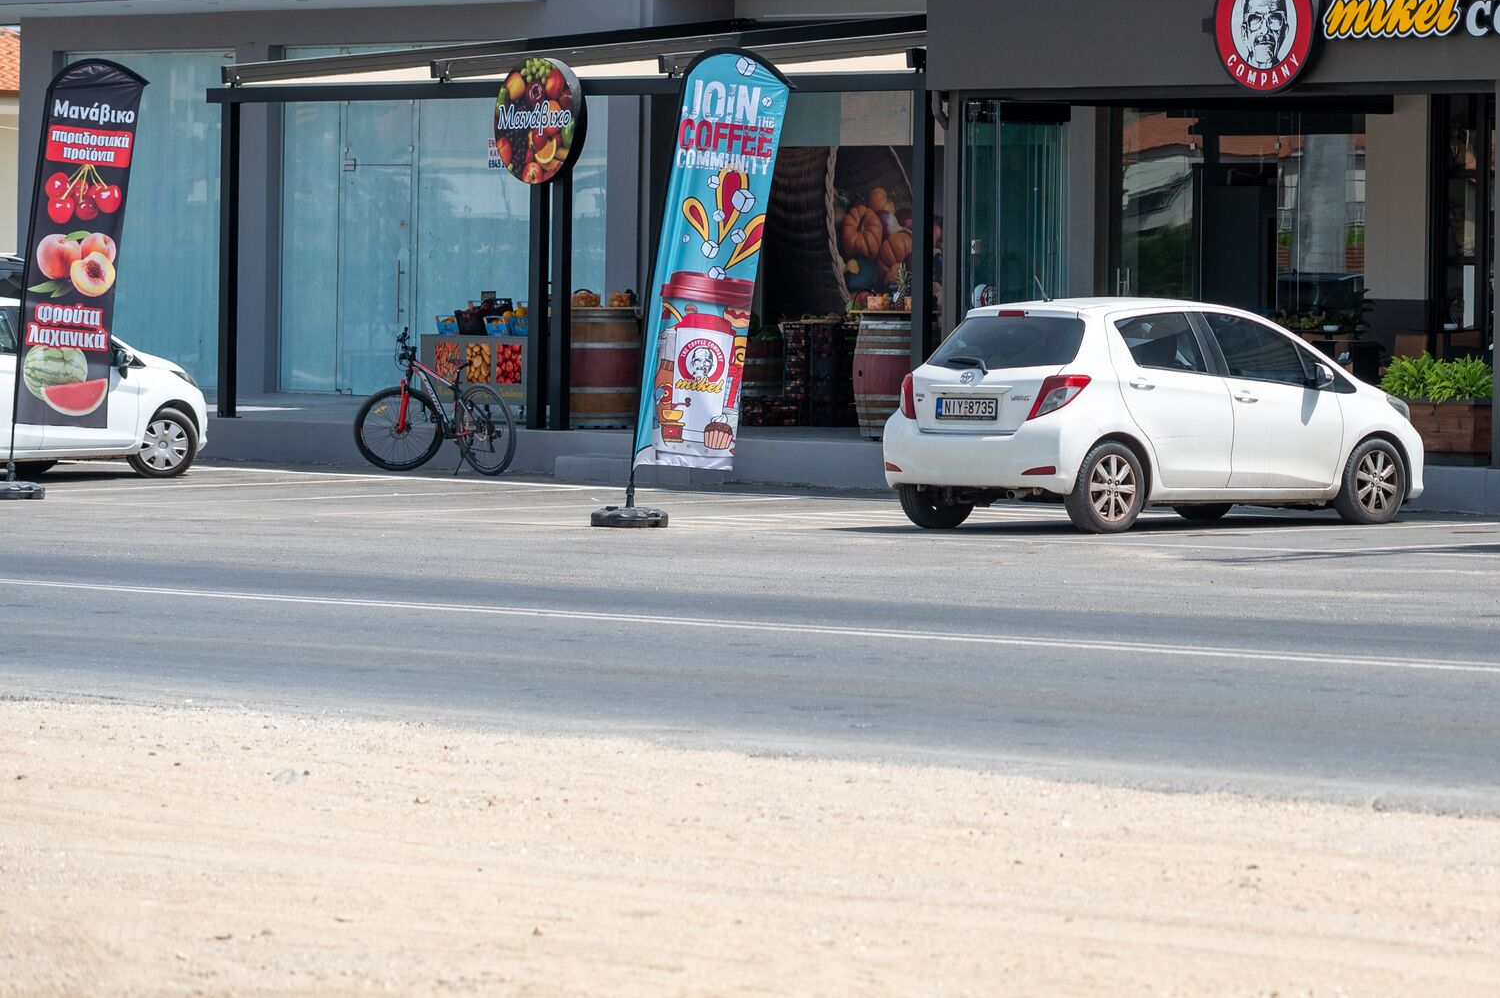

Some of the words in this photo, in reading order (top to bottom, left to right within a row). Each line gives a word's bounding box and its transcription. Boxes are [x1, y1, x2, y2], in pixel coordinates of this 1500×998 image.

[1227, 53, 1299, 86] COMPANY
[53, 99, 135, 125] Μανάβικο
[681, 79, 761, 126] JOIN
[758, 116, 775, 128] THE
[498, 101, 571, 135] Μανάβικο
[52, 129, 130, 148] παραδοσιακά
[678, 118, 774, 158] COFFEE
[63, 146, 115, 162] προϊόντα
[676, 149, 771, 175] COMMUNITY
[37, 305, 101, 326] φρούτα
[28, 324, 106, 349] λαχανικά
[675, 376, 724, 393] mikel
